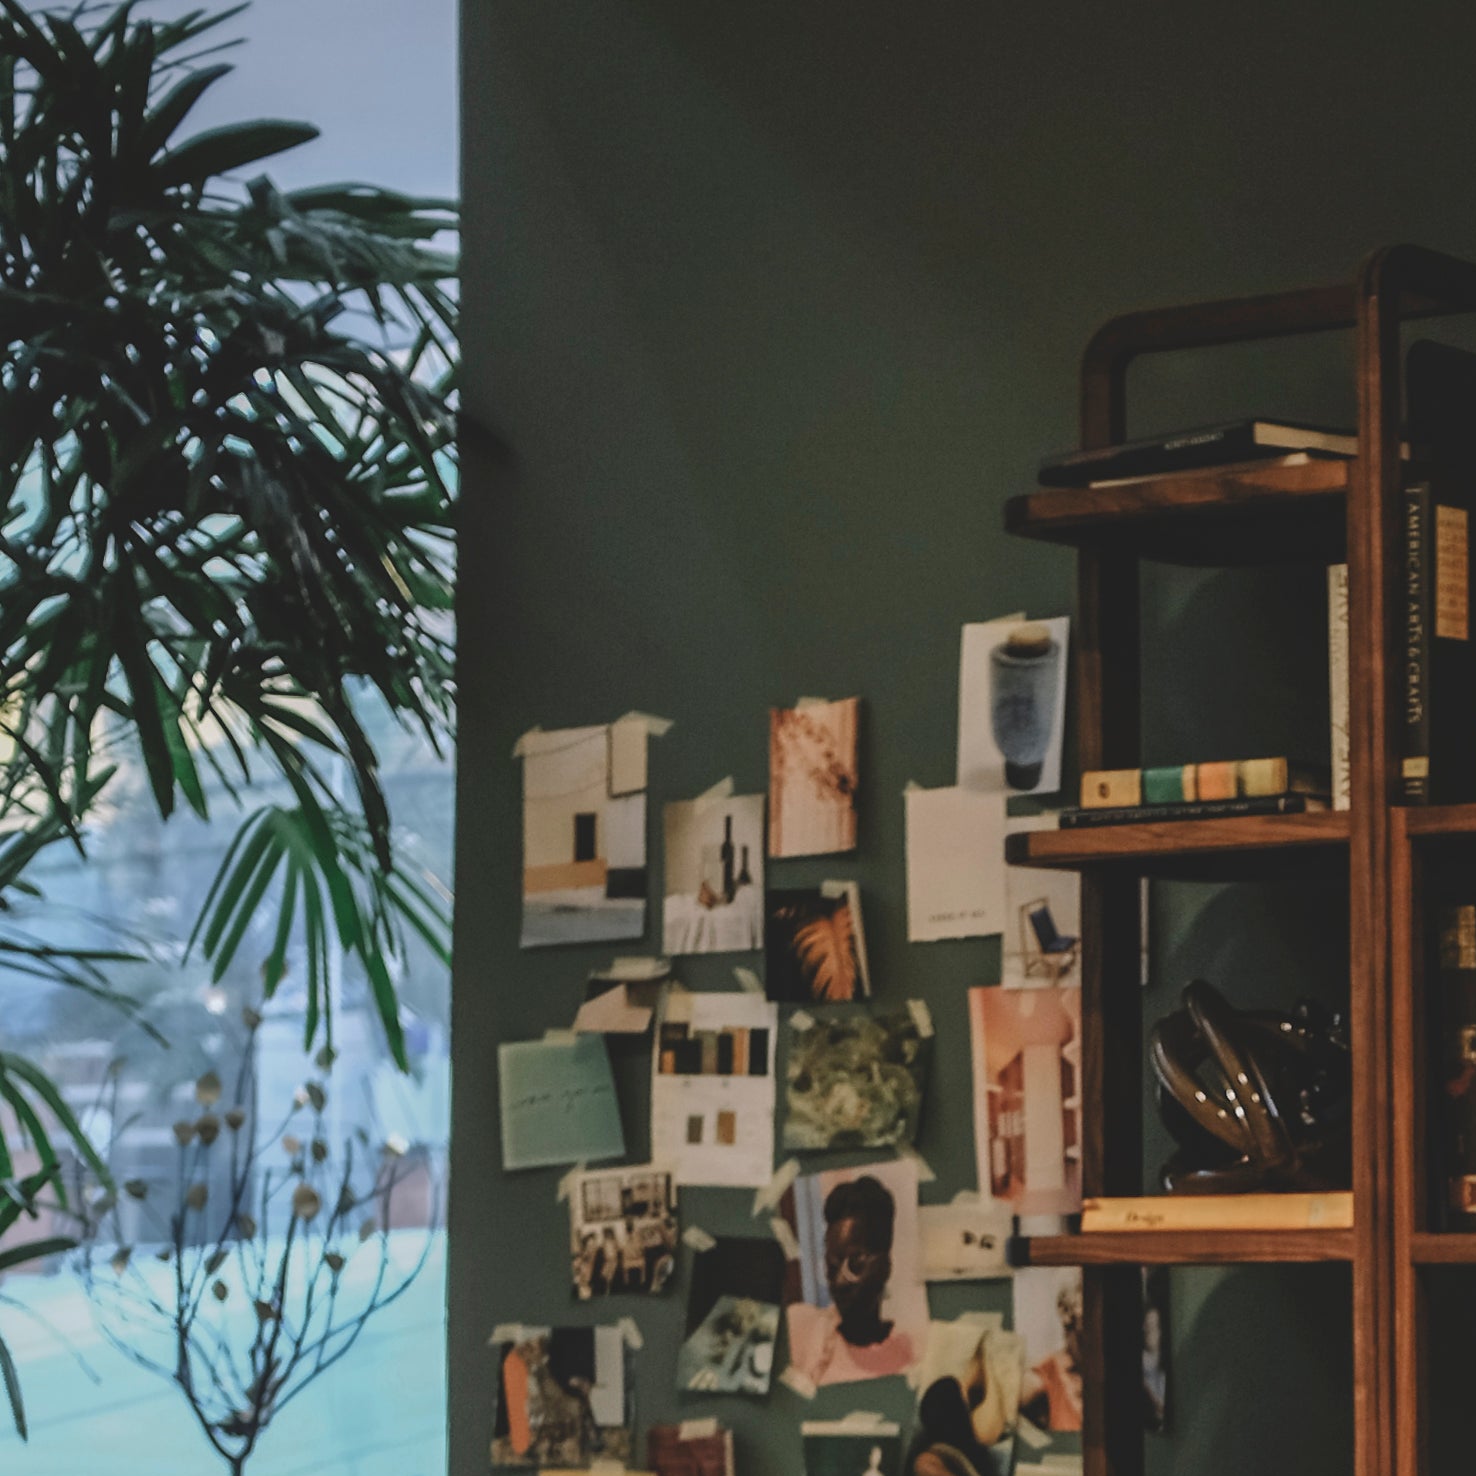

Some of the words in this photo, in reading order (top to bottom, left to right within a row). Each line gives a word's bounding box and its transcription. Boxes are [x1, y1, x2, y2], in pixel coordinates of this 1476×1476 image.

[1407, 502, 1421, 595] AMERICAN
[1408, 602, 1423, 643] ARTS
[1409, 664, 1424, 724] CRAFTS
